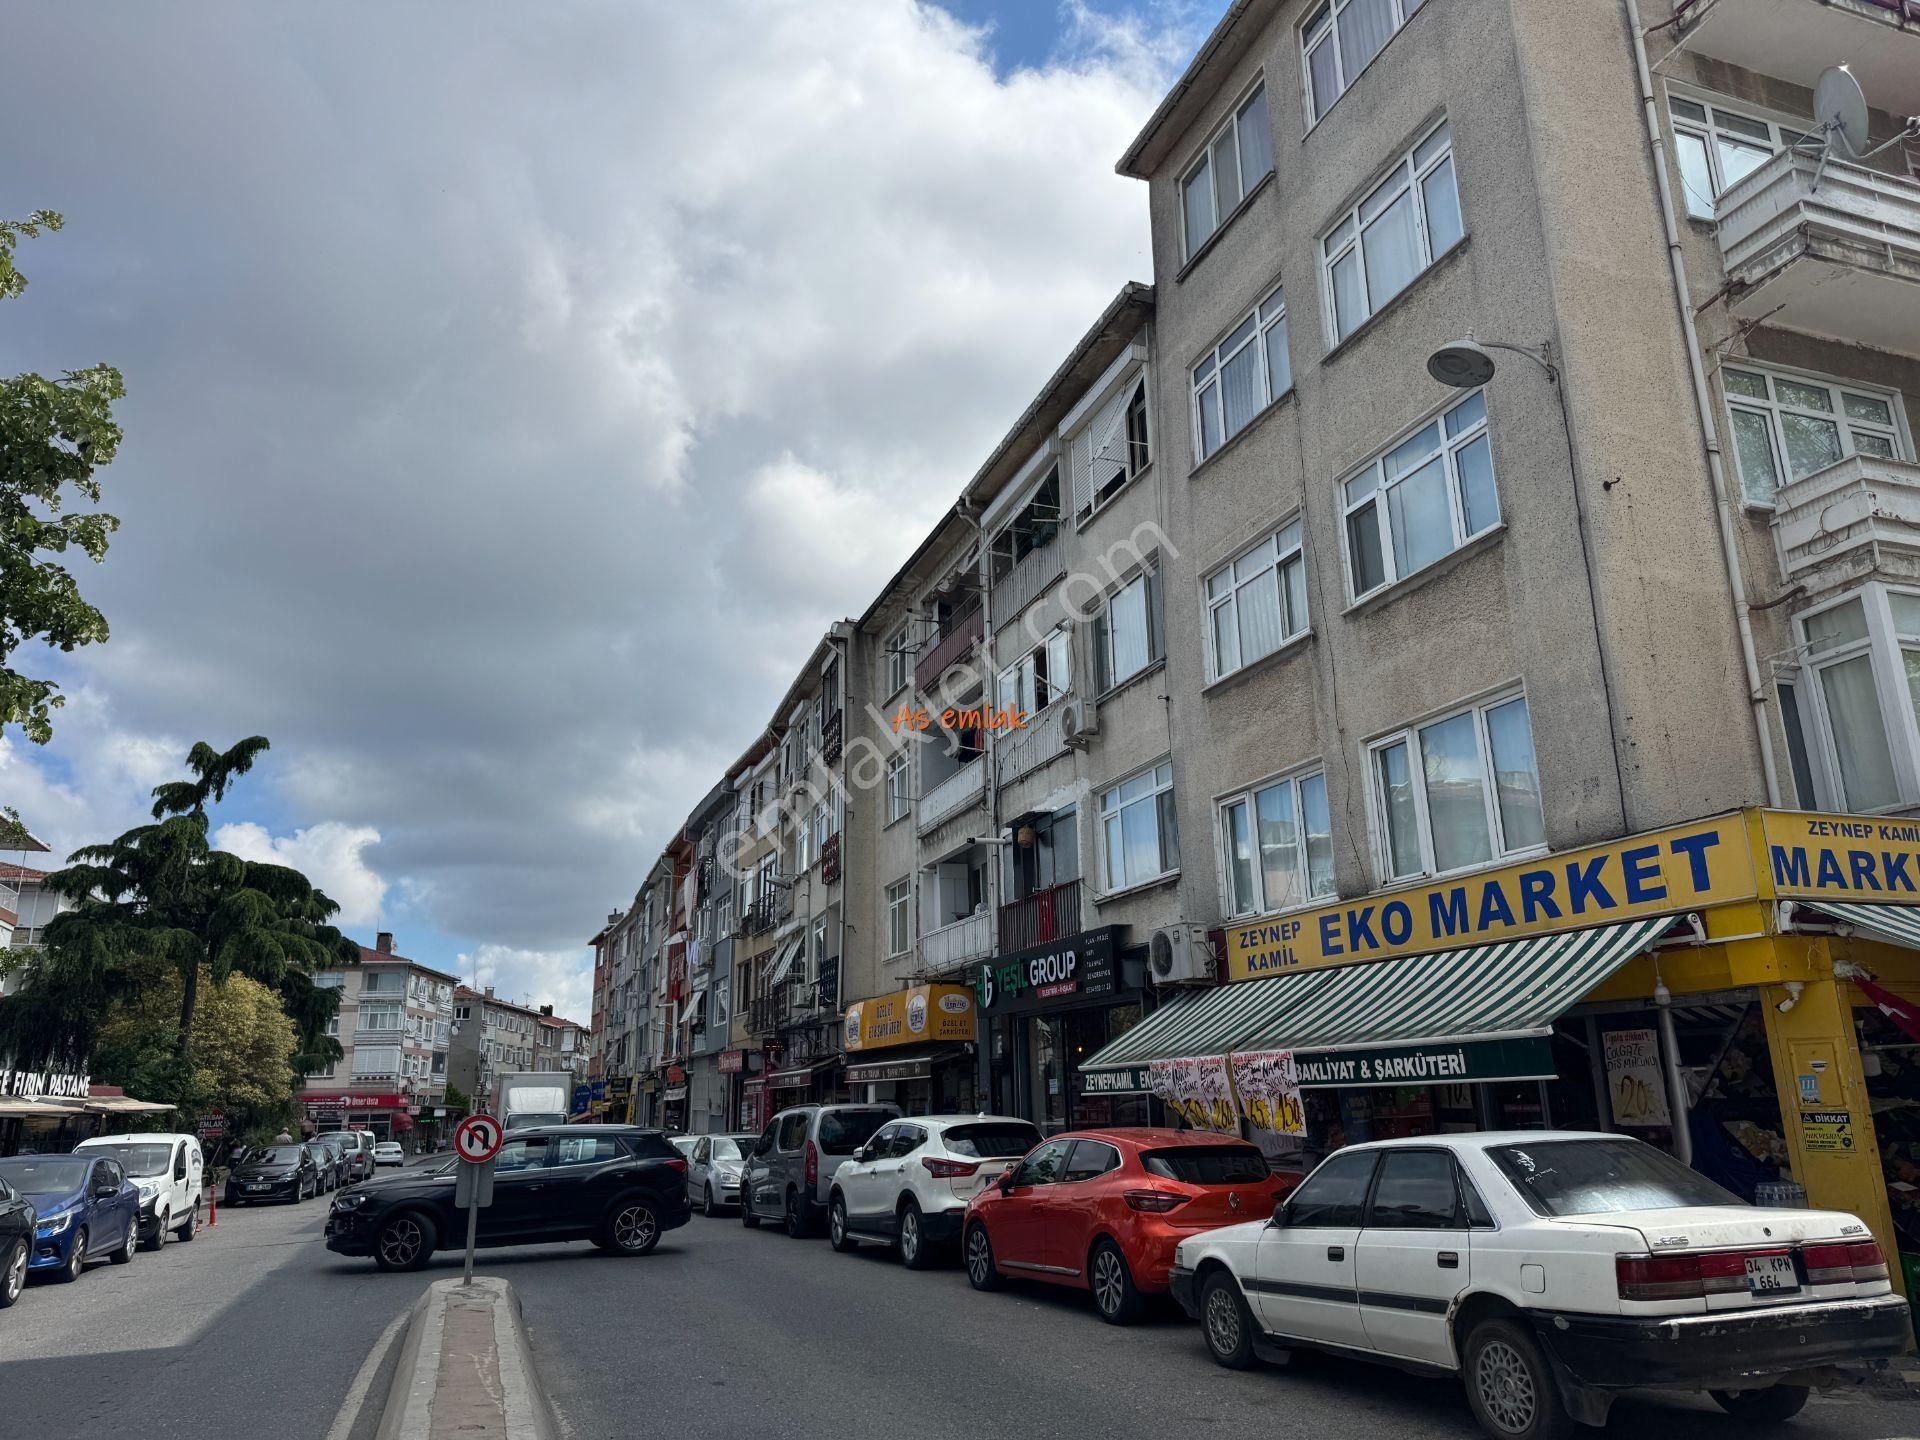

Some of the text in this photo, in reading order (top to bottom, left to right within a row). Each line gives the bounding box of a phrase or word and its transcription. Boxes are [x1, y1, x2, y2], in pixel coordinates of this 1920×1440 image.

[1807, 820, 1873, 839] ZEYNEP
[1771, 845, 1920, 893] MARK
[1319, 831, 1720, 957] EKO MARKET
[1240, 920, 1301, 949] ZEYNEP
[1247, 944, 1299, 972] KAMİL
[995, 950, 1076, 997] YEŞİL GROUP
[1296, 1049, 1467, 1081] BAKLİYAT & ŞARKÜTERİ
[48, 1073, 91, 1097] PASTANE
[1085, 1069, 1134, 1091] ZEYNEPKAMİL
[1139, 1070, 1154, 1089] EK
[1815, 1114, 1848, 1123] DİKKAT
[1746, 1257, 1791, 1273] 34 KPN
[1759, 1274, 1781, 1289] 664
